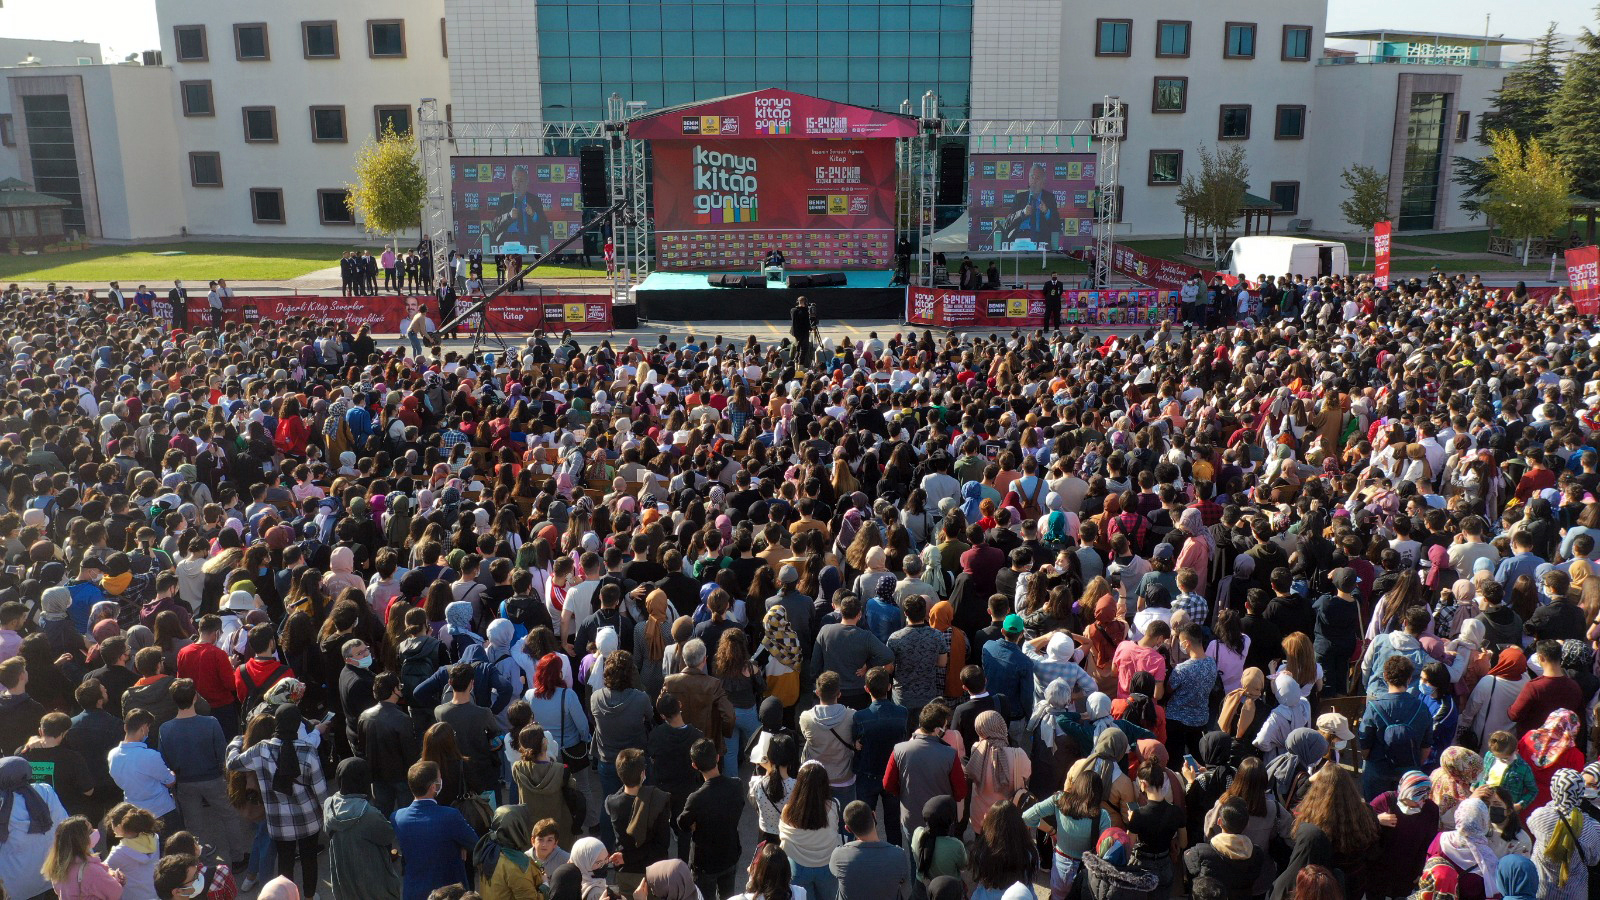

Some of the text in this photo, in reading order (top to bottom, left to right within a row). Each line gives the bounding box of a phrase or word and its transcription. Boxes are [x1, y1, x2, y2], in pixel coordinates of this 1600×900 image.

[755, 96, 790, 108] konya
[755, 106, 790, 120] kitap
[755, 119, 791, 130] günleri
[806, 118, 829, 128] 15-24
[694, 145, 757, 174] konya
[816, 166, 840, 178] 15-24
[694, 165, 758, 196] kitap
[694, 192, 758, 214] günleri
[308, 302, 328, 313] Kitap
[330, 301, 364, 310] Severler
[504, 312, 524, 321] Kitap
